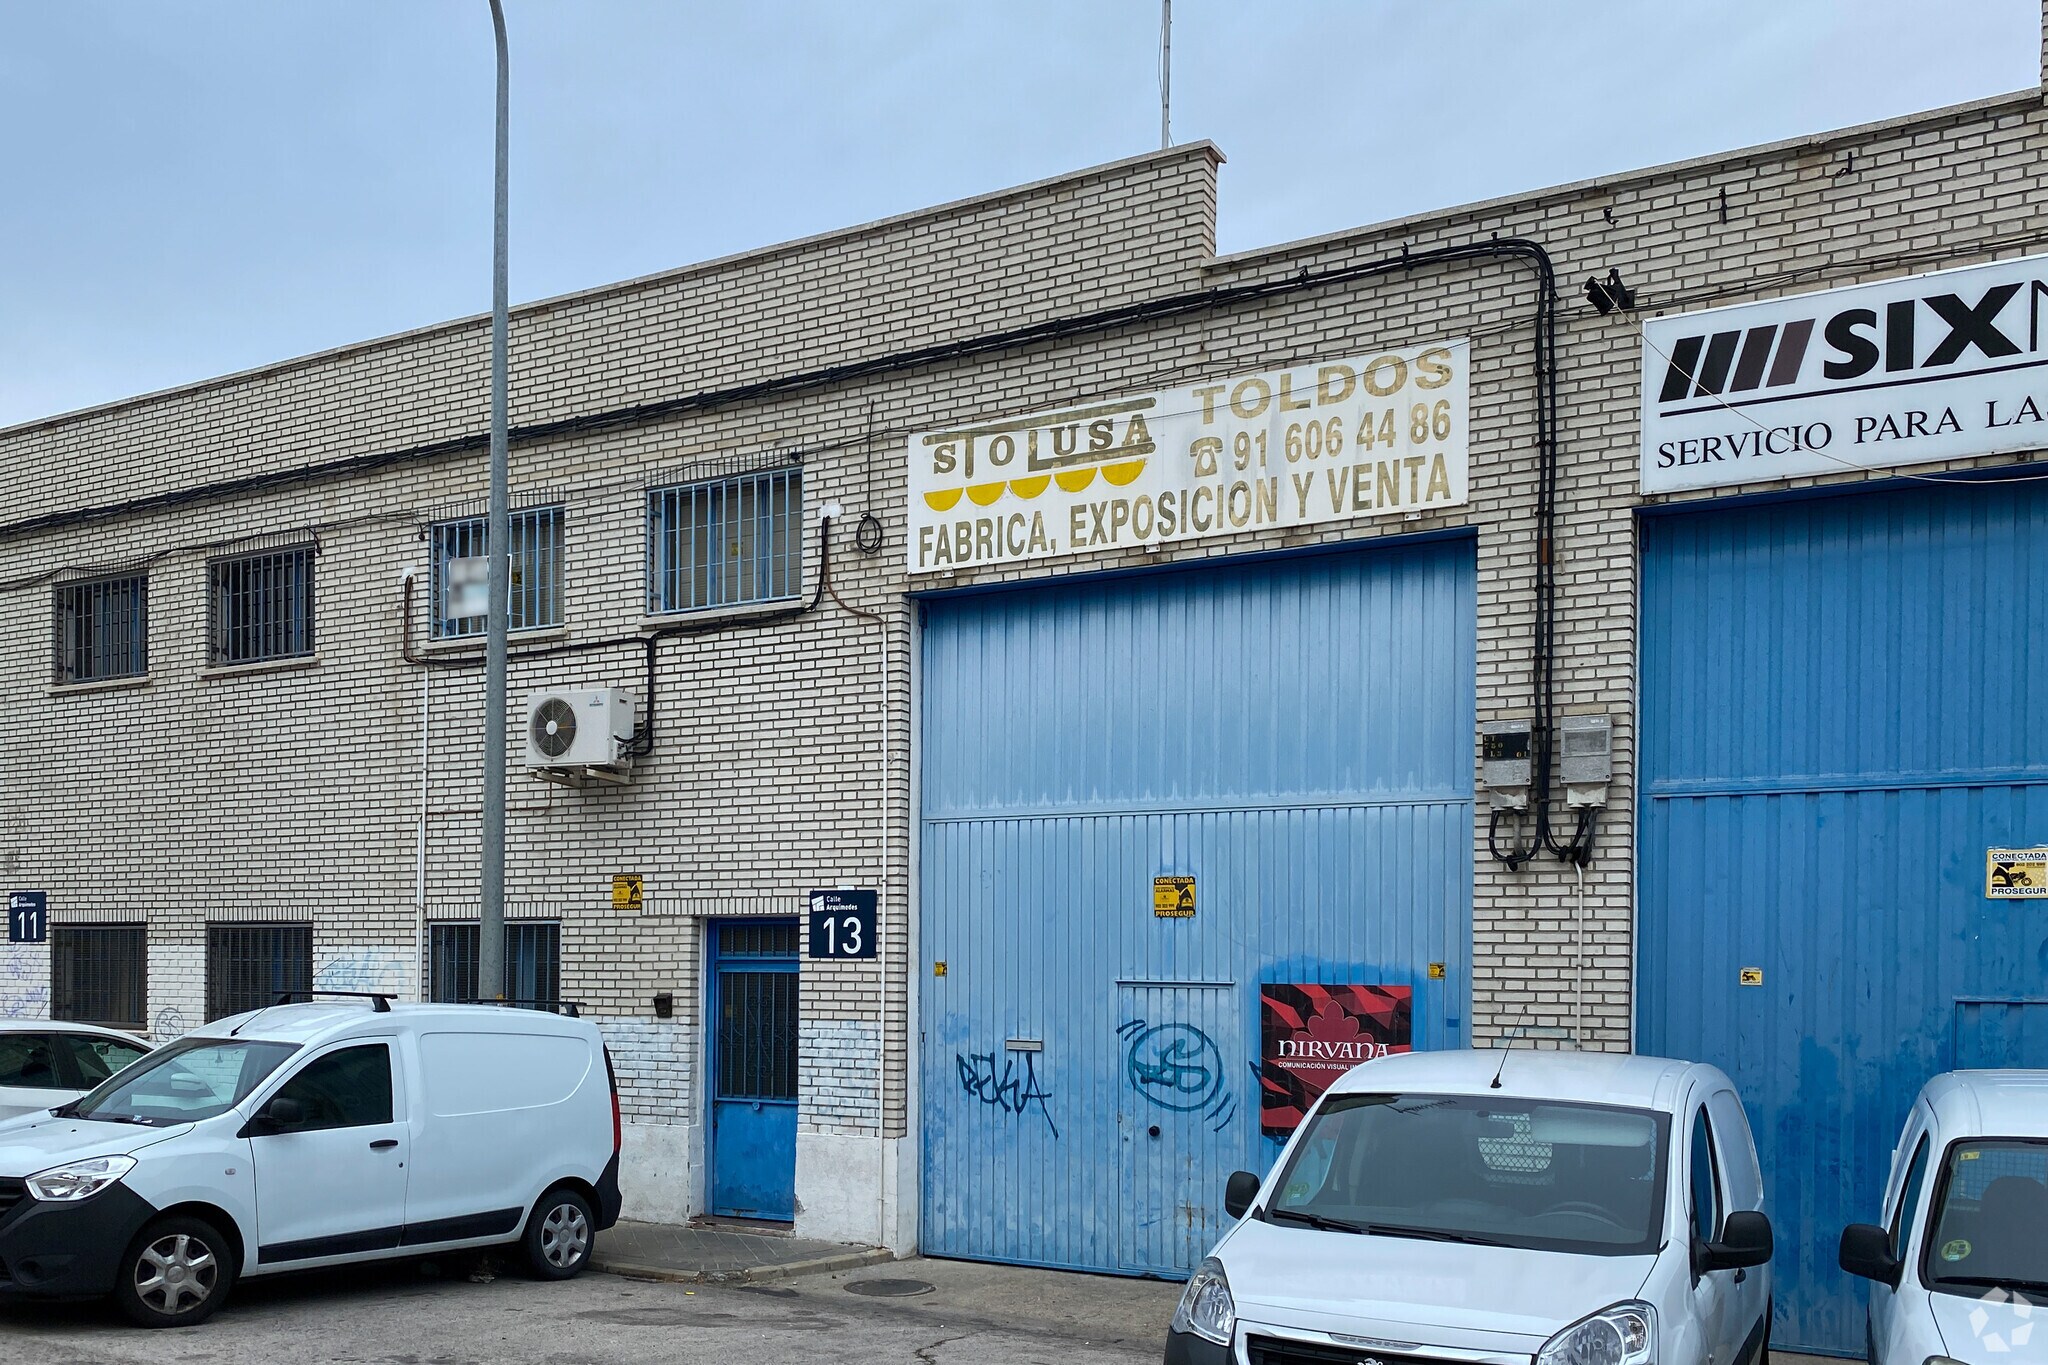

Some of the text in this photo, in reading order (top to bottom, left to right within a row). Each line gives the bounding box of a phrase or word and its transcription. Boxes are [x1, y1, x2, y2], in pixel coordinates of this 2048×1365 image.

[1192, 347, 1454, 425] TOLDOS
[1233, 399, 1452, 471] 91 606 44 86
[1657, 395, 2048, 469] SERVICIO PARA LA
[918, 452, 1452, 568] FABRICA, EXPOSICION Y VENTA
[18, 911, 37, 939] 11
[823, 916, 862, 954] 13
[1278, 1039, 1390, 1060] NIRVANA
[1278, 1060, 1326, 1070] COMUNICACIÓN
[1327, 1062, 1349, 1071] VISUAL
